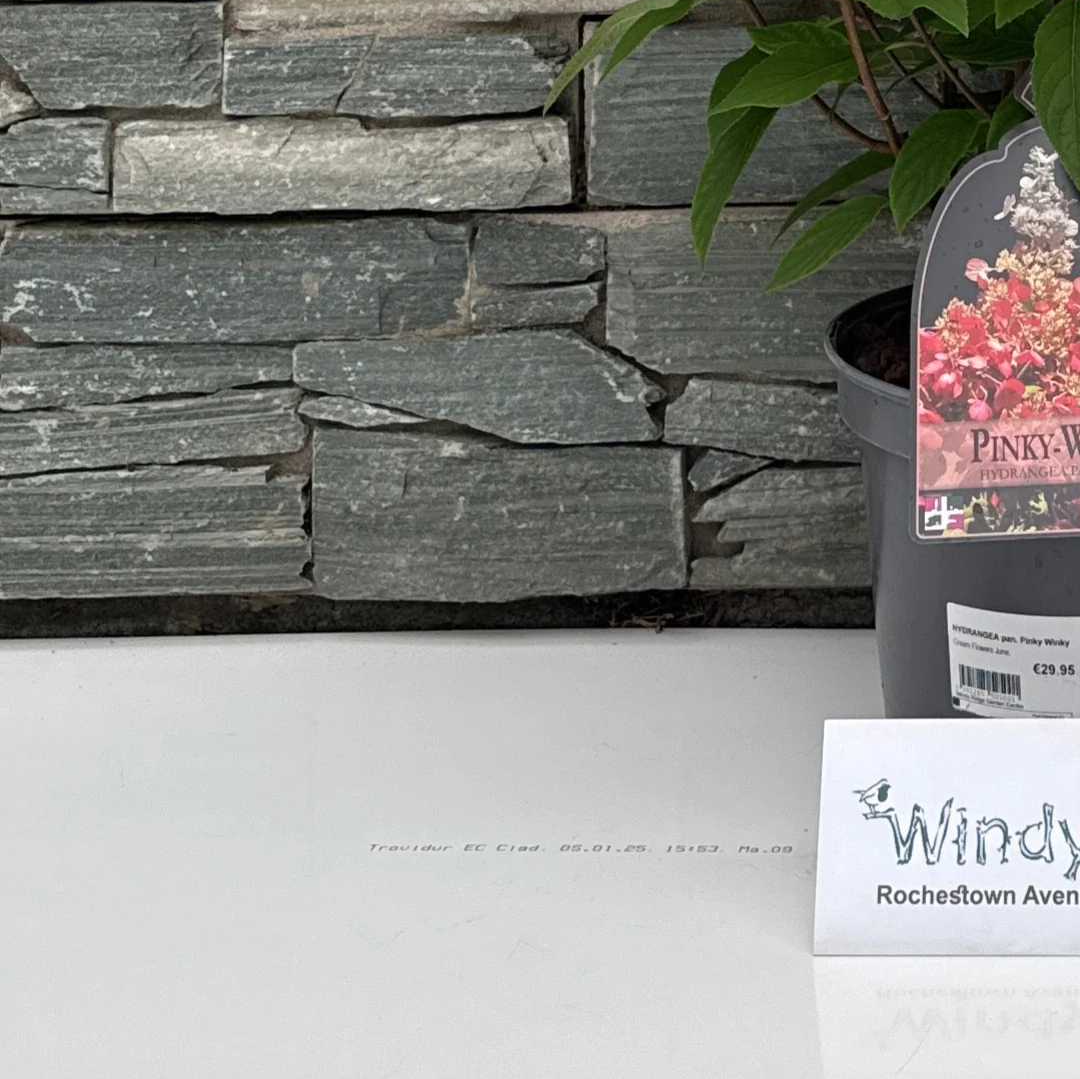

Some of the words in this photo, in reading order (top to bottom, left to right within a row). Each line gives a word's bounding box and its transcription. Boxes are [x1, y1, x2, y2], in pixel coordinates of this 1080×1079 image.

[980, 466, 1065, 481] HYDRANGEA
[952, 623, 999, 640] HYDRANGEA
[1001, 635, 1018, 643] pan.
[1020, 636, 1042, 647] Pinky
[1044, 638, 1070, 648] Winky
[1033, 663, 1075, 676] €29.95
[463, 843, 487, 852] EC
[876, 884, 1016, 907] Rochestown
